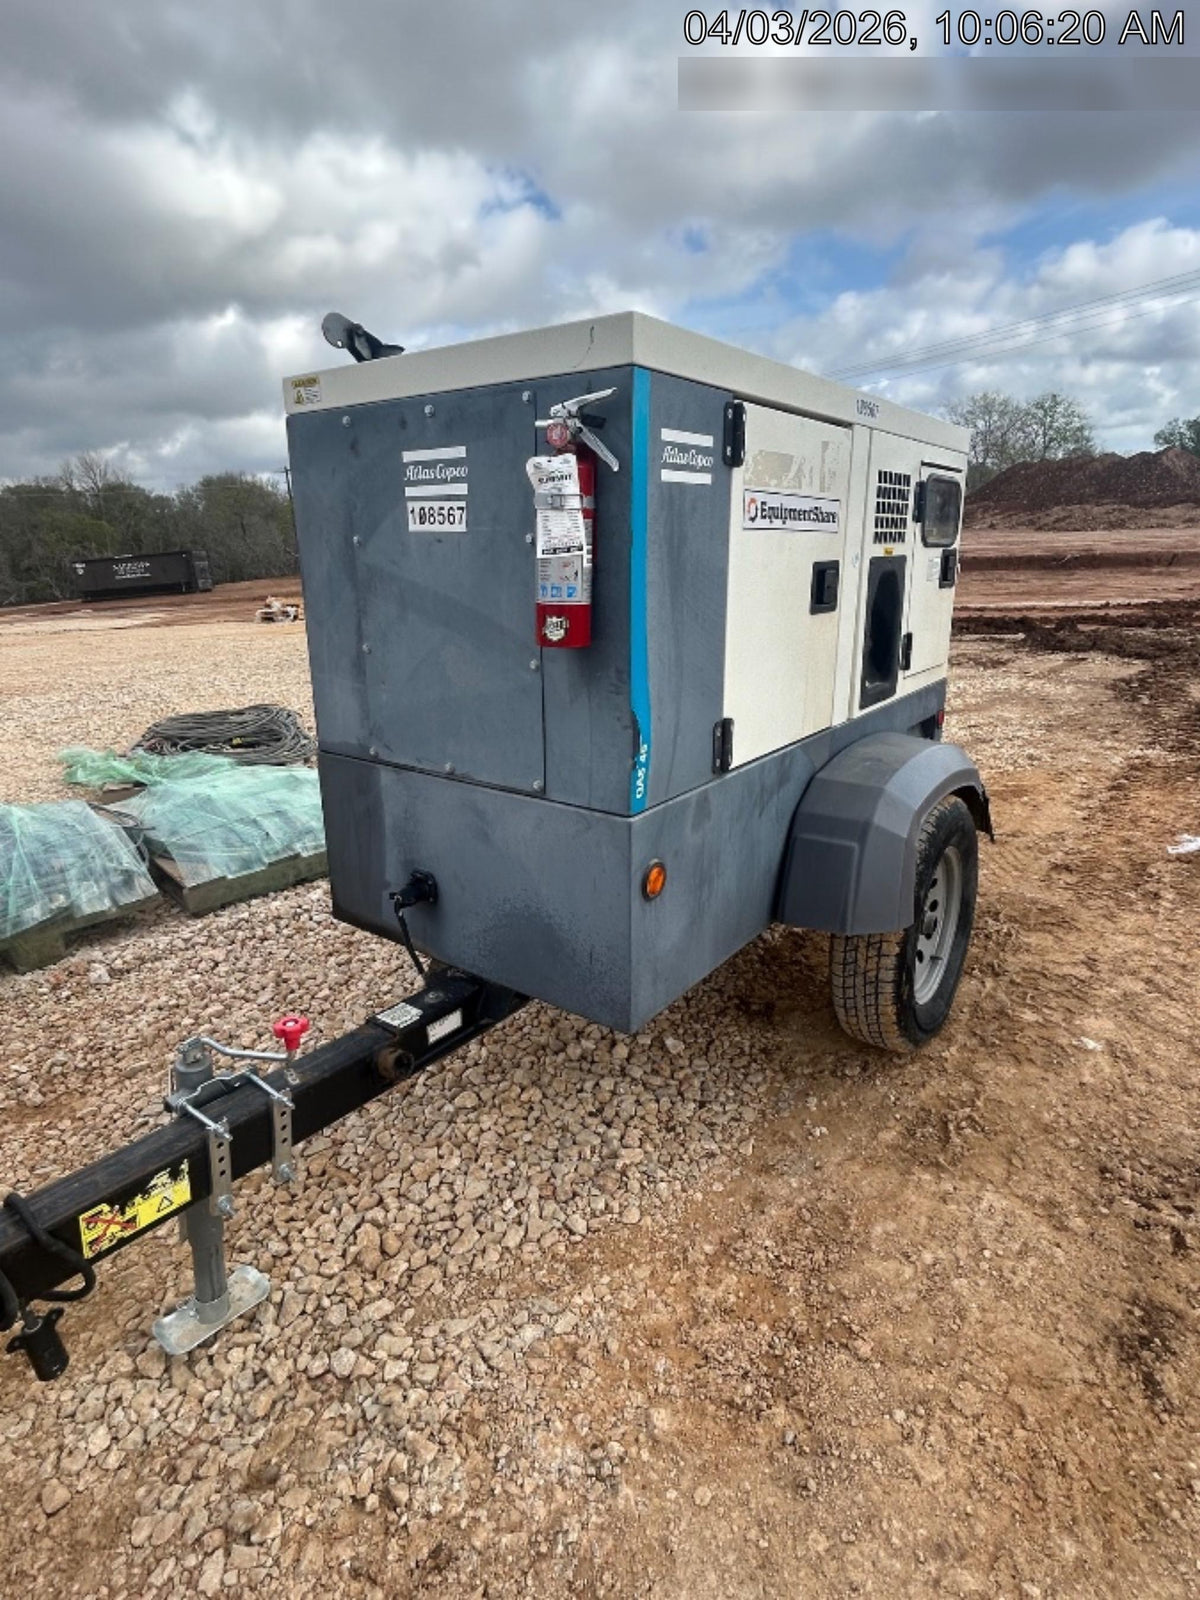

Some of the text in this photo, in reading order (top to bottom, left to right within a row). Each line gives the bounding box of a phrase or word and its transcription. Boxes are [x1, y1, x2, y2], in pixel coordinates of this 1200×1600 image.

[661, 445, 688, 465] Atlas
[404, 463, 468, 482] Atlas Copco
[409, 505, 466, 526] 108567
[760, 500, 838, 525] EquipmentShare
